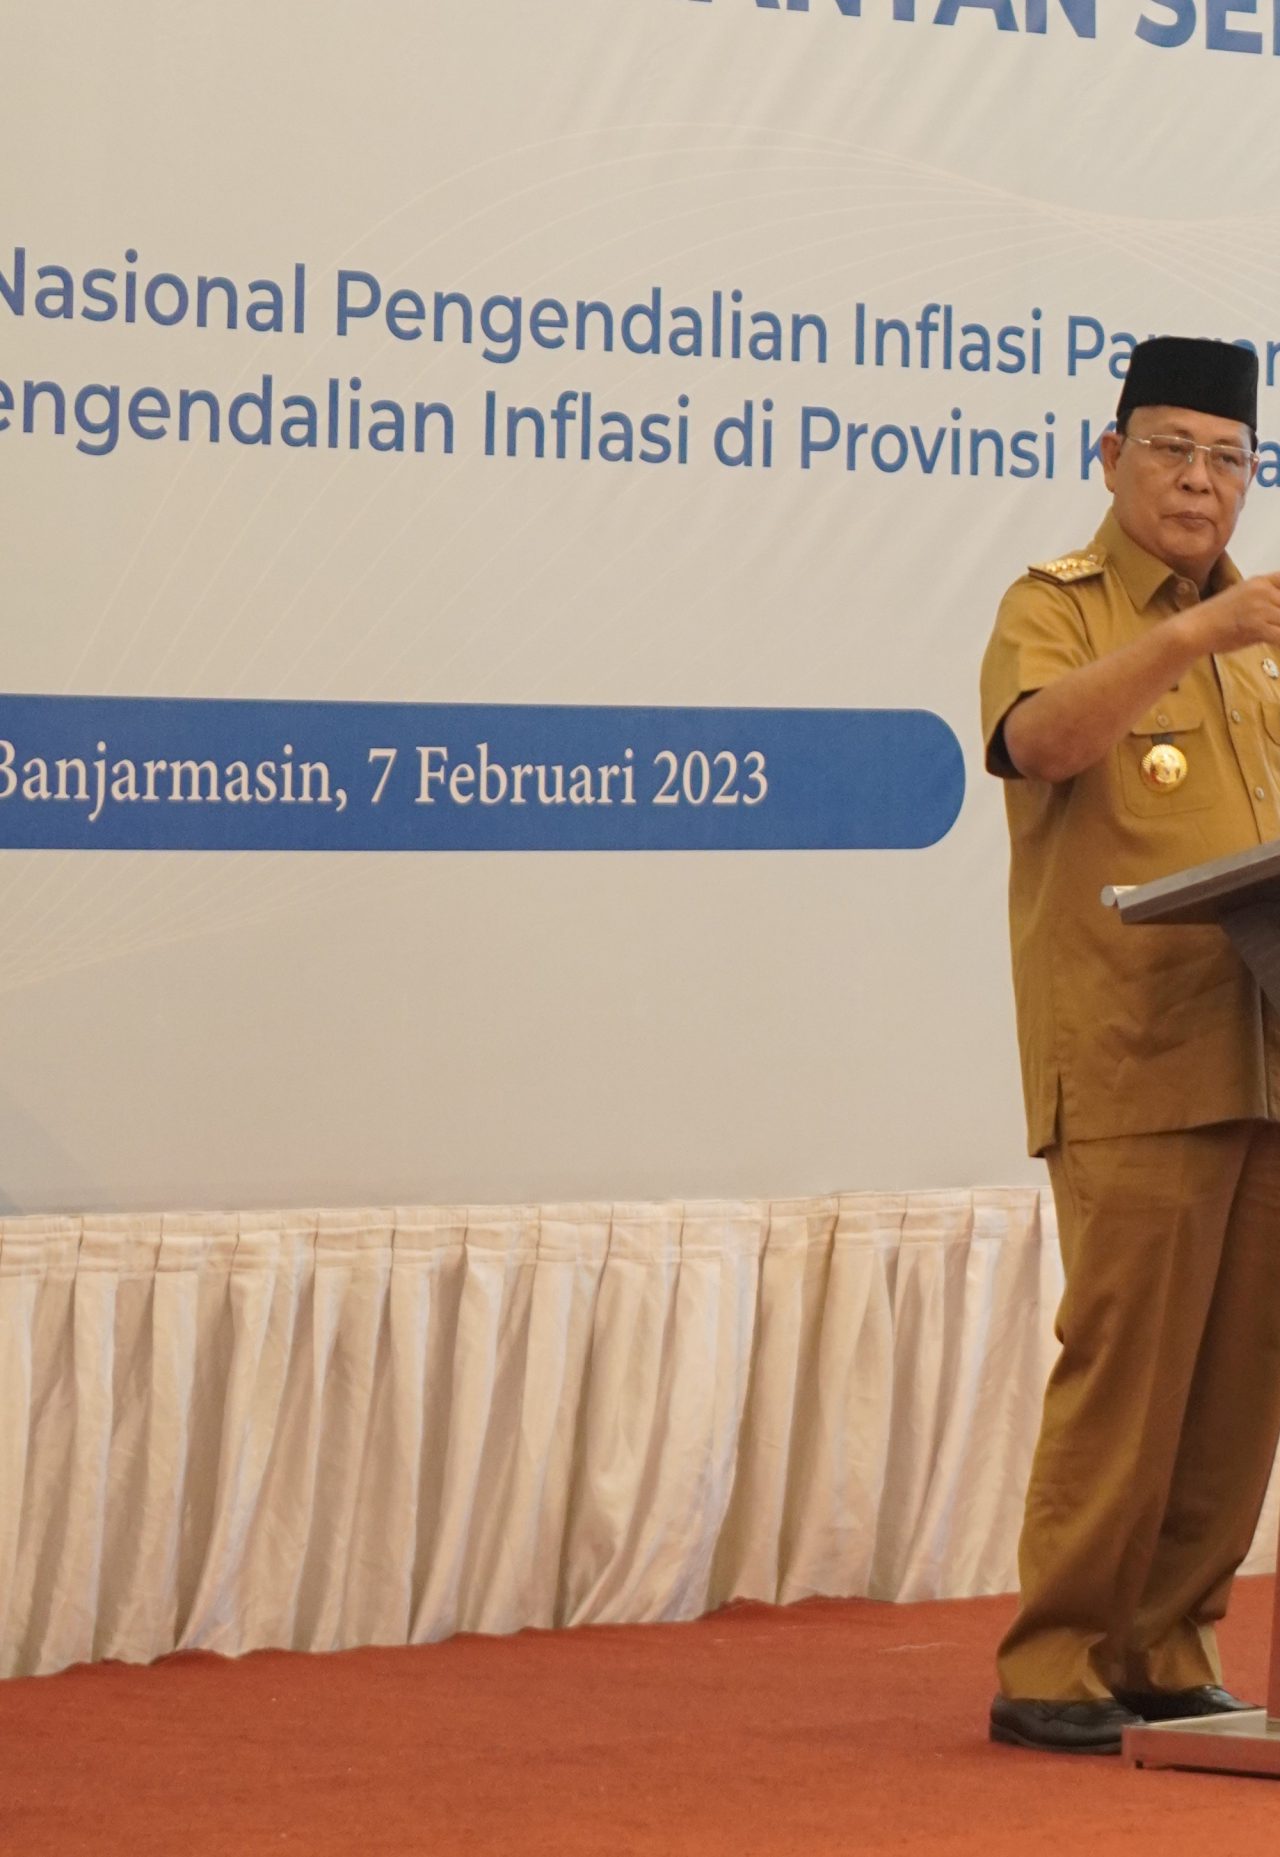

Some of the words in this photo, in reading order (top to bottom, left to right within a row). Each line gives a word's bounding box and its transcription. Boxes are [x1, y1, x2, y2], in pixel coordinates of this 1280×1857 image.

[336, 270, 828, 365] Pengendalian
[855, 303, 1043, 375] Inflasi
[484, 390, 690, 466] Inflasi
[714, 399, 774, 469] di
[800, 406, 1056, 481] Provinsi
[367, 747, 398, 803] 7
[415, 742, 638, 805] Februari
[652, 750, 769, 805] 2023
